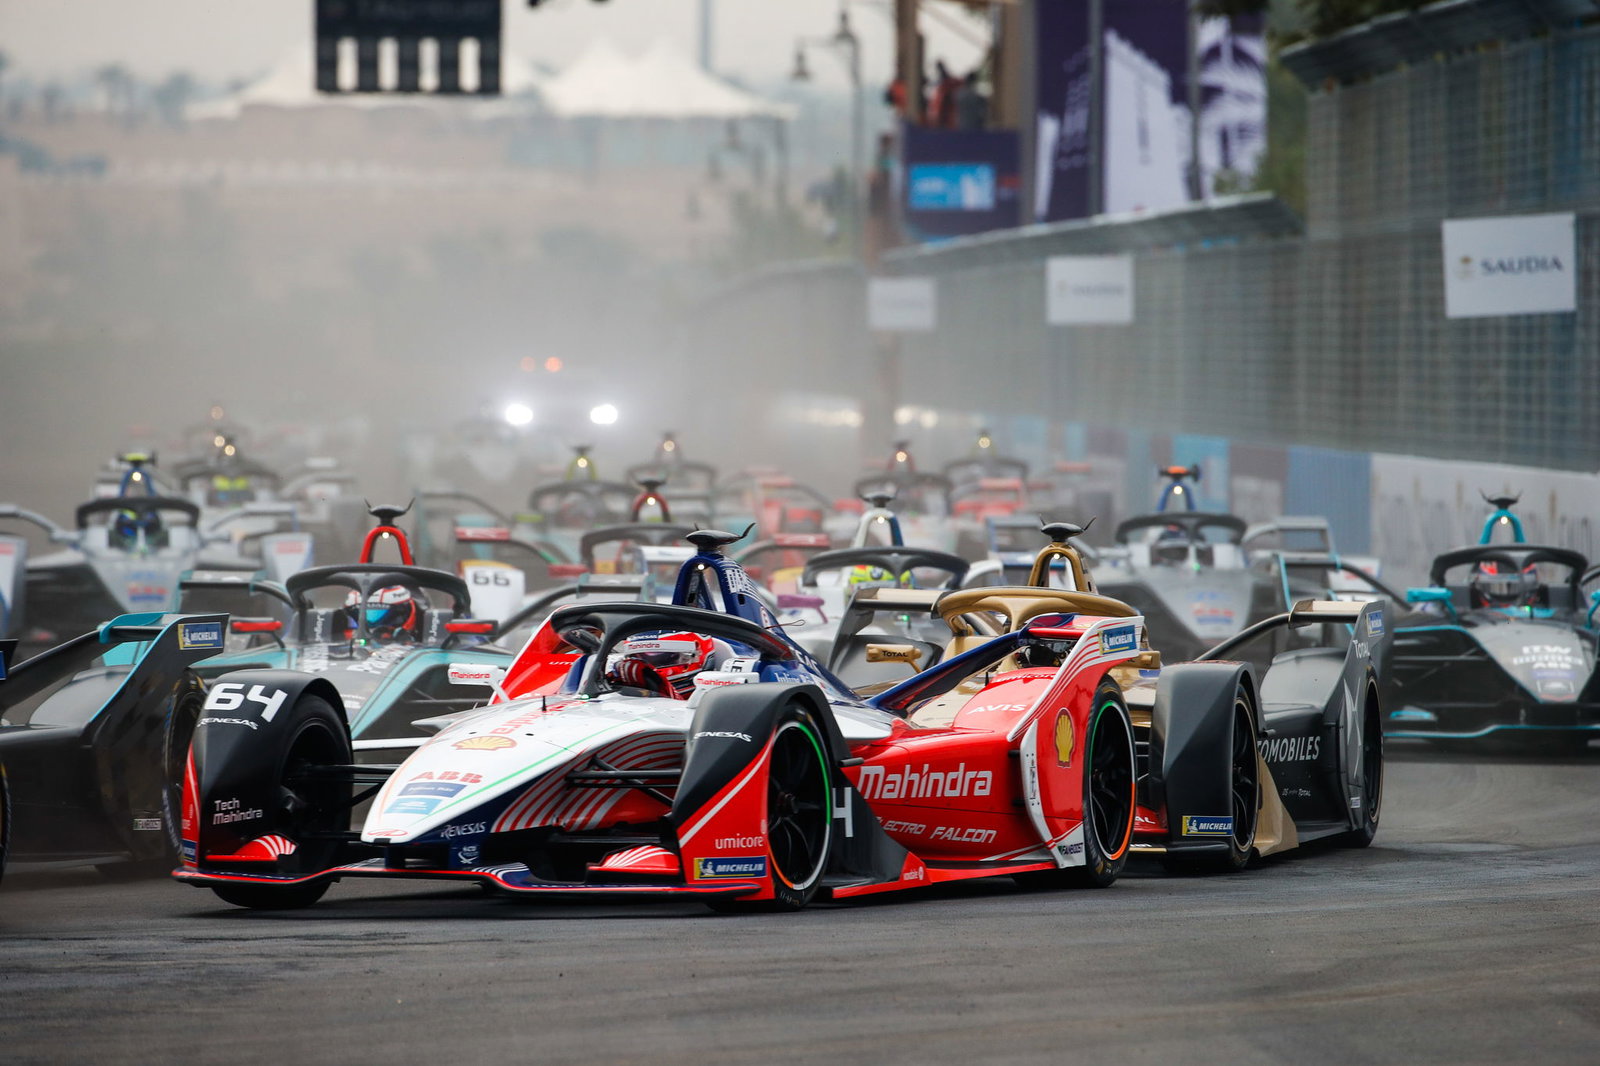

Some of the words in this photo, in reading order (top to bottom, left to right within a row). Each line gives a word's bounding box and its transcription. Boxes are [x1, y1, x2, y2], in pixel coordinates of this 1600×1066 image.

[1481, 255, 1563, 276] SAUDIA
[473, 570, 510, 586] 66
[1109, 633, 1133, 646] MICHELIN
[882, 650, 908, 658] TOTAL
[450, 671, 491, 680] Mahindra
[204, 683, 288, 722] 64
[966, 704, 1027, 714] AVIS
[406, 771, 483, 783] ABB
[857, 763, 993, 799] Mahindra
[214, 797, 240, 812] Tech
[212, 807, 263, 825] Mahindra
[440, 821, 486, 839] RENESAS
[929, 827, 997, 844] FALCON
[715, 833, 764, 849] umicore
[716, 863, 764, 873] MICHELIN
